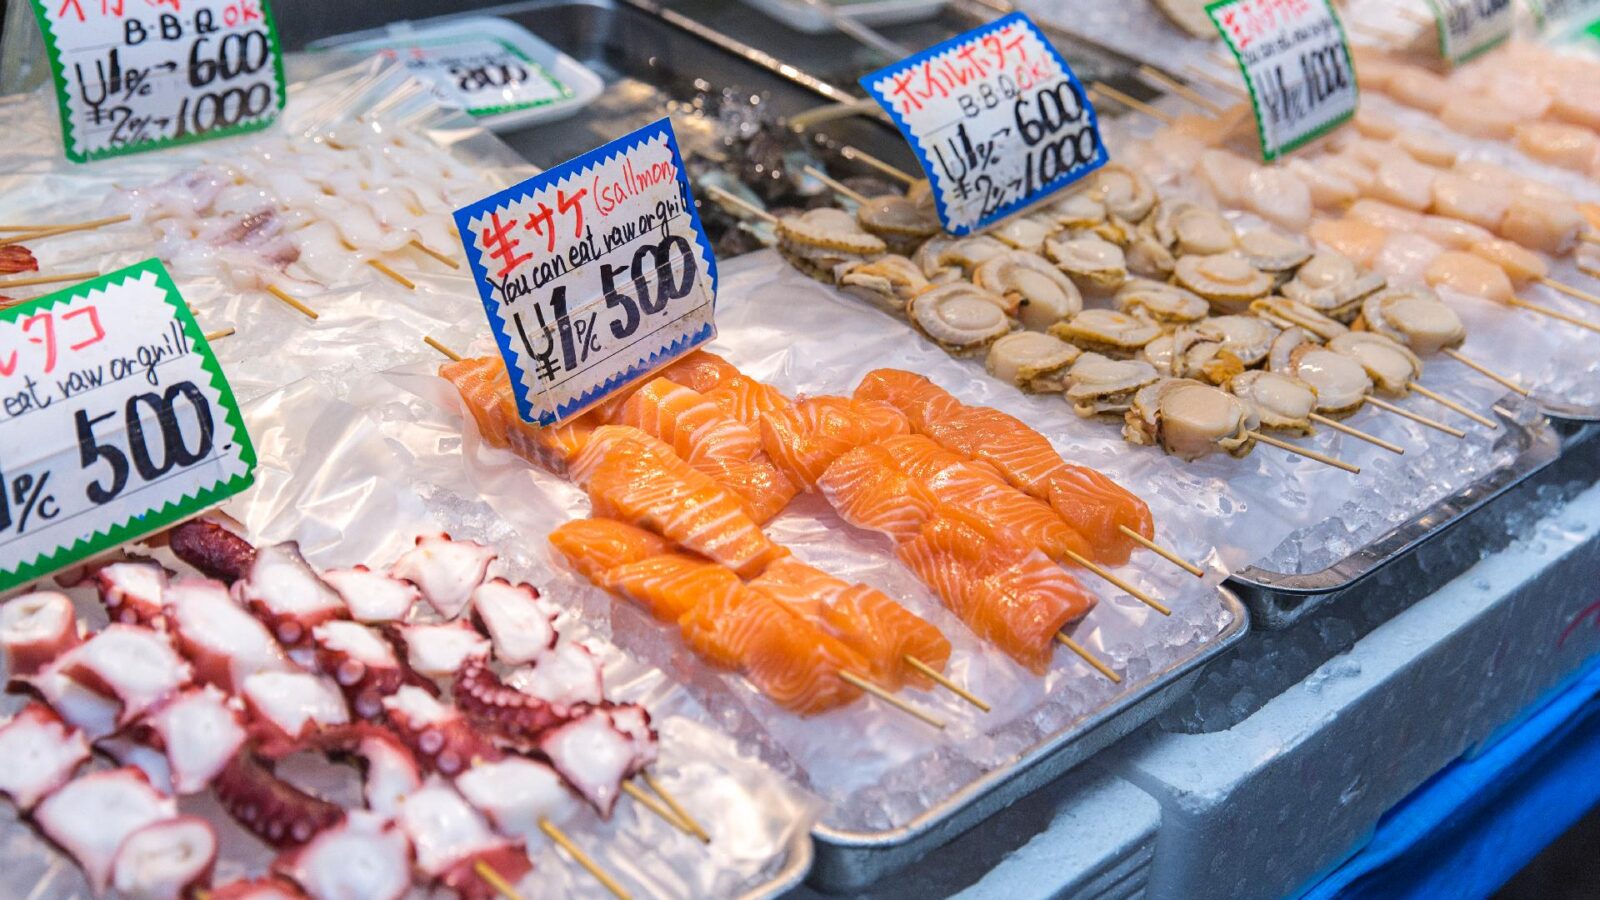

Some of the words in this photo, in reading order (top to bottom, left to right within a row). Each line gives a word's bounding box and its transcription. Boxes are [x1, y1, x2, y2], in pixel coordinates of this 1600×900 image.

[189, 30, 269, 88] 600
[174, 83, 272, 139] 1000
[1014, 81, 1082, 147] 600
[1025, 126, 1098, 198] 1000
[483, 188, 588, 278] 生サケ
[486, 273, 532, 306] You
[532, 254, 568, 288] can
[568, 225, 602, 268] eat
[602, 222, 636, 254] raw
[600, 234, 696, 340] 500
[3, 374, 52, 417] eat
[56, 364, 103, 399] raw
